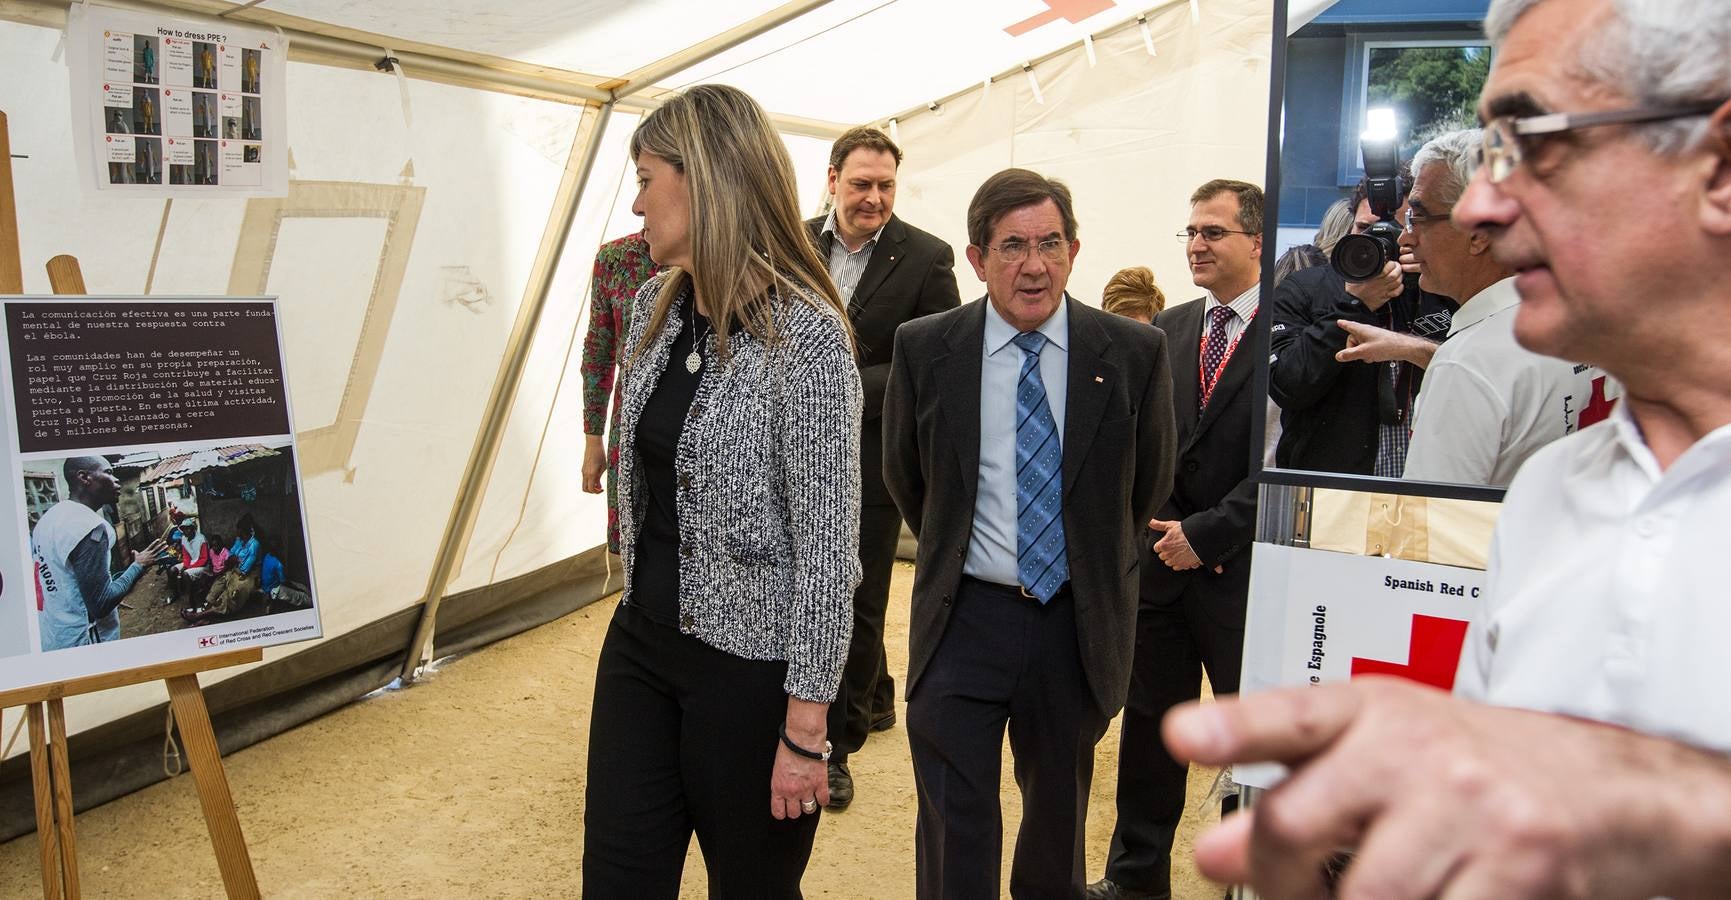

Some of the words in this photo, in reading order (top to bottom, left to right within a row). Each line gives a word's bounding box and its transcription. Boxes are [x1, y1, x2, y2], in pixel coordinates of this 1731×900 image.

[157, 26, 174, 36] How
[174, 30, 183, 38] to
[184, 31, 206, 41] dress
[207, 33, 221, 43] PPE
[22, 311, 35, 319] La
[41, 311, 117, 319] comunicación
[121, 310, 169, 318] efectiva
[212, 310, 240, 319] parte
[22, 321, 62, 329] mental
[67, 321, 81, 329] de
[135, 321, 187, 329] respuesta
[24, 332, 37, 340] el
[43, 332, 81, 340] ébola.
[26, 354, 46, 362] Las
[52, 352, 121, 361] comunidades
[126, 351, 145, 359] han
[150, 350, 163, 358] de
[167, 349, 224, 359] desempeñar
[28, 364, 47, 372] rol
[53, 365, 73, 373] muy
[79, 362, 117, 372] amplio
[157, 360, 192, 370] propia
[197, 358, 261, 368] preparación,
[28, 374, 61, 385] papel
[67, 375, 87, 384] que
[92, 373, 118, 381] Cruz
[123, 372, 147, 381] Roja
[153, 370, 210, 379] contribuye
[226, 367, 273, 376] facilitar
[29, 386, 81, 394] mediante
[88, 384, 100, 392] la
[106, 380, 178, 391] distribución
[182, 380, 194, 388] de
[199, 378, 243, 387] material
[248, 377, 280, 385] educa-
[31, 396, 62, 405] tivo,
[70, 395, 83, 403] la
[88, 392, 144, 404] promoción
[167, 390, 179, 398] la
[184, 389, 213, 398] salud
[217, 390, 224, 398] y
[228, 388, 266, 396] visitas
[32, 408, 72, 418] puerta
[90, 405, 132, 414] puerta.
[138, 402, 151, 410] En
[185, 400, 219, 408] última
[224, 396, 276, 406] actividad,
[33, 419, 60, 427] Cruz
[66, 416, 91, 426] Roja
[97, 415, 110, 423] ha
[116, 412, 170, 422] alcanzado
[187, 410, 215, 418] cerca
[34, 430, 48, 438] de
[54, 428, 61, 436] 5
[66, 426, 117, 436] millones
[123, 424, 135, 432] de
[141, 422, 193, 431] personas.
[1384, 575, 1434, 593] Spanish
[1440, 582, 1464, 597] Red
[218, 629, 249, 639] International
[249, 626, 275, 635] Federation
[272, 628, 294, 637] Crescent
[294, 624, 315, 633] Societies
[1307, 605, 1327, 670] Espagnole
